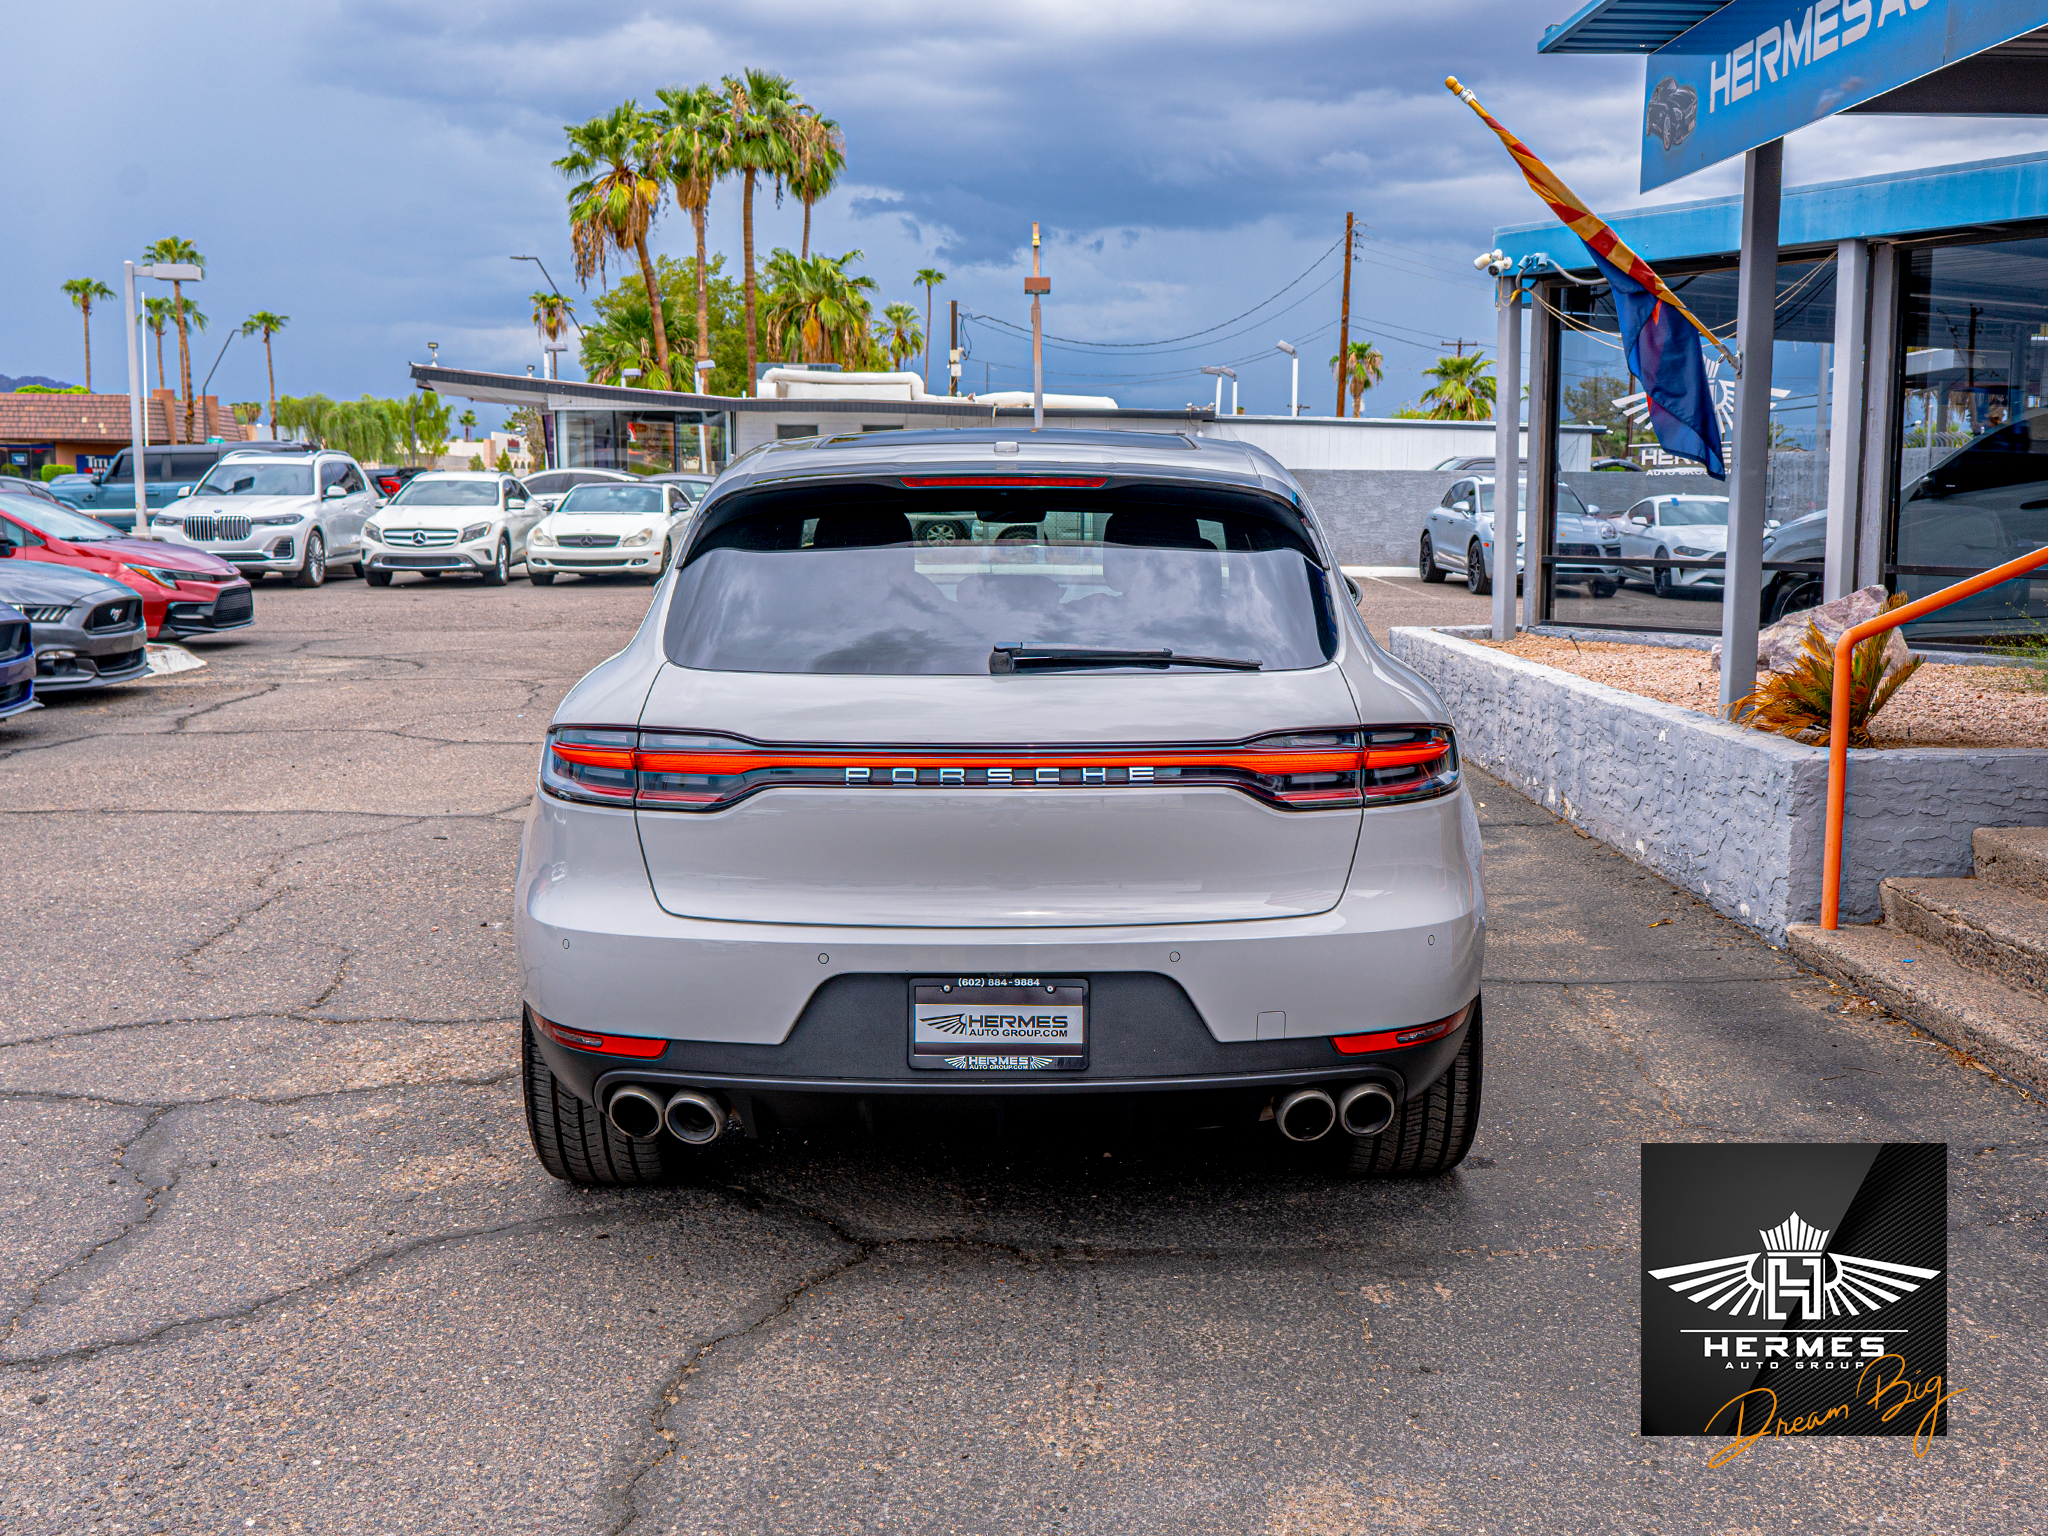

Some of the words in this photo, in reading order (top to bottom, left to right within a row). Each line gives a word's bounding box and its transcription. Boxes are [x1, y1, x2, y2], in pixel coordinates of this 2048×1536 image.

[1709, 0, 1873, 114] HERMES
[1645, 468, 1676, 476] AUTO
[845, 767, 1155, 785] PORSCHE
[958, 978, 985, 988] (602)
[968, 1015, 1068, 1028] HERMES
[969, 1029, 999, 1037] AUTO
[1002, 1029, 1068, 1038] GROUP.COM
[969, 1056, 1029, 1065] HERMES
